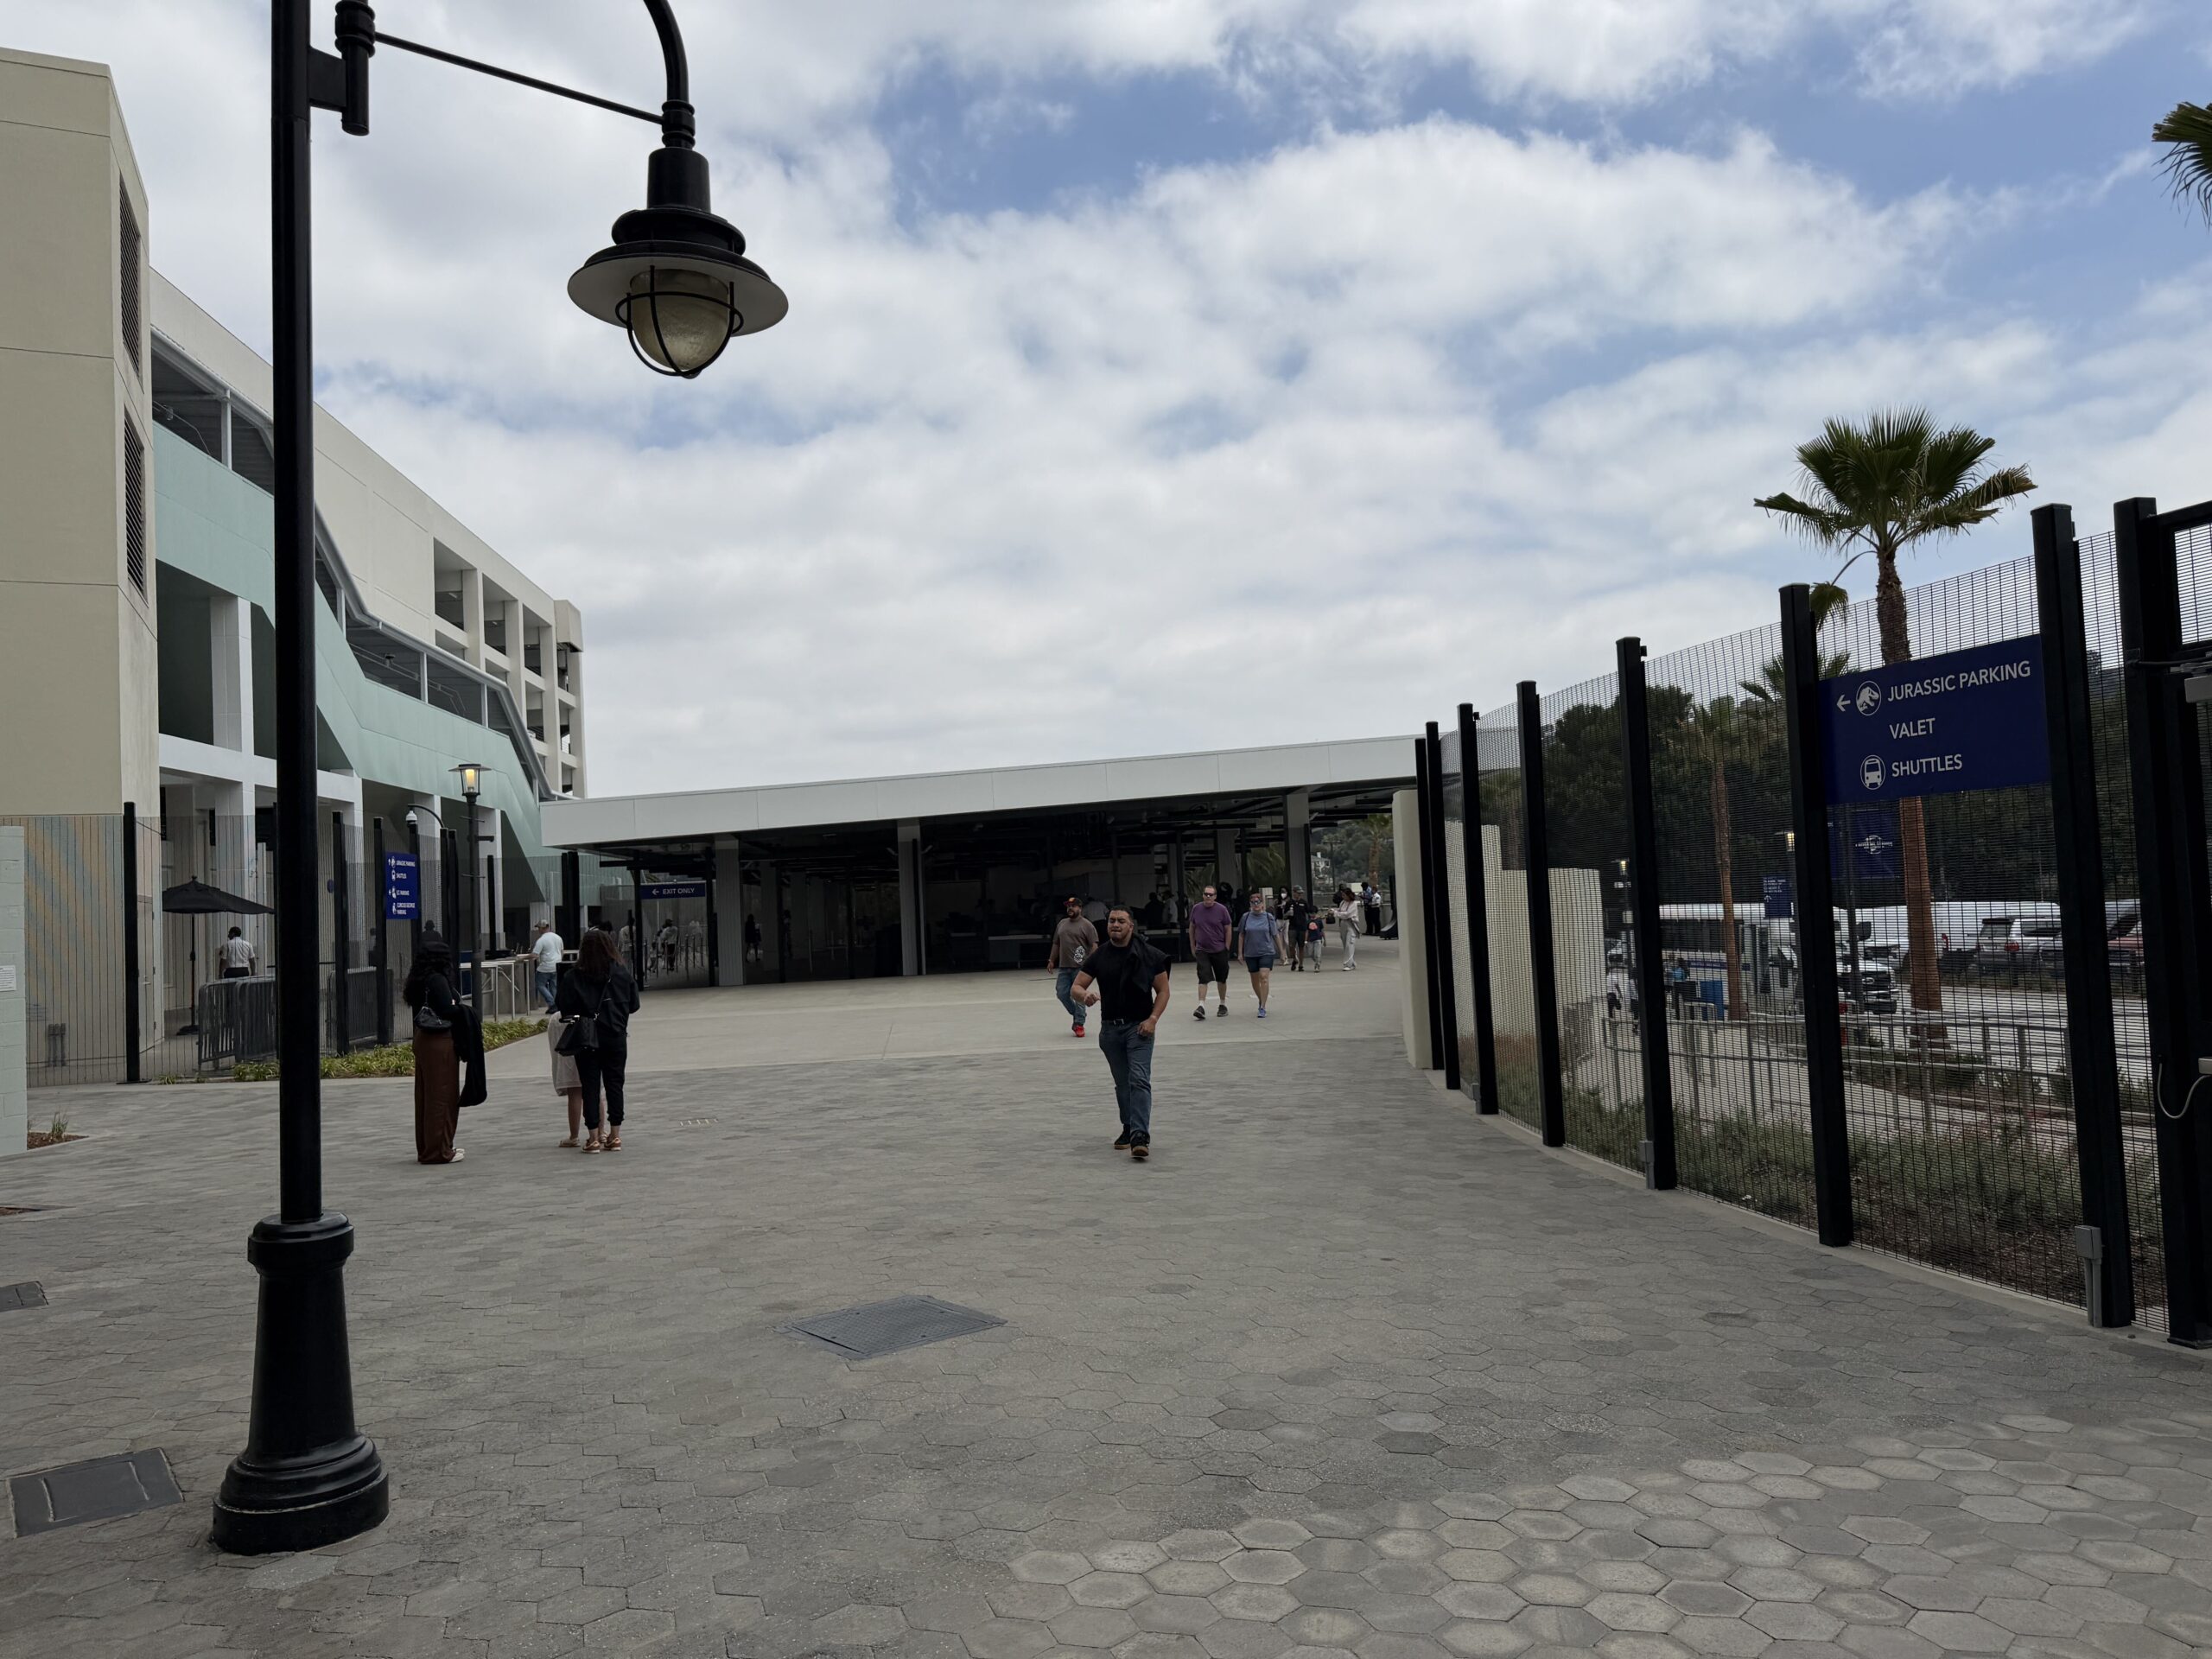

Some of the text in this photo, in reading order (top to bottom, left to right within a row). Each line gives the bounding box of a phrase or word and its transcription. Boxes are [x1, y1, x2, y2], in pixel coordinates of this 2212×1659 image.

[1887, 660, 2031, 702] JURASSIC PARKING
[1889, 717, 1936, 740] VALET
[1891, 754, 1963, 778] SHUTTLES
